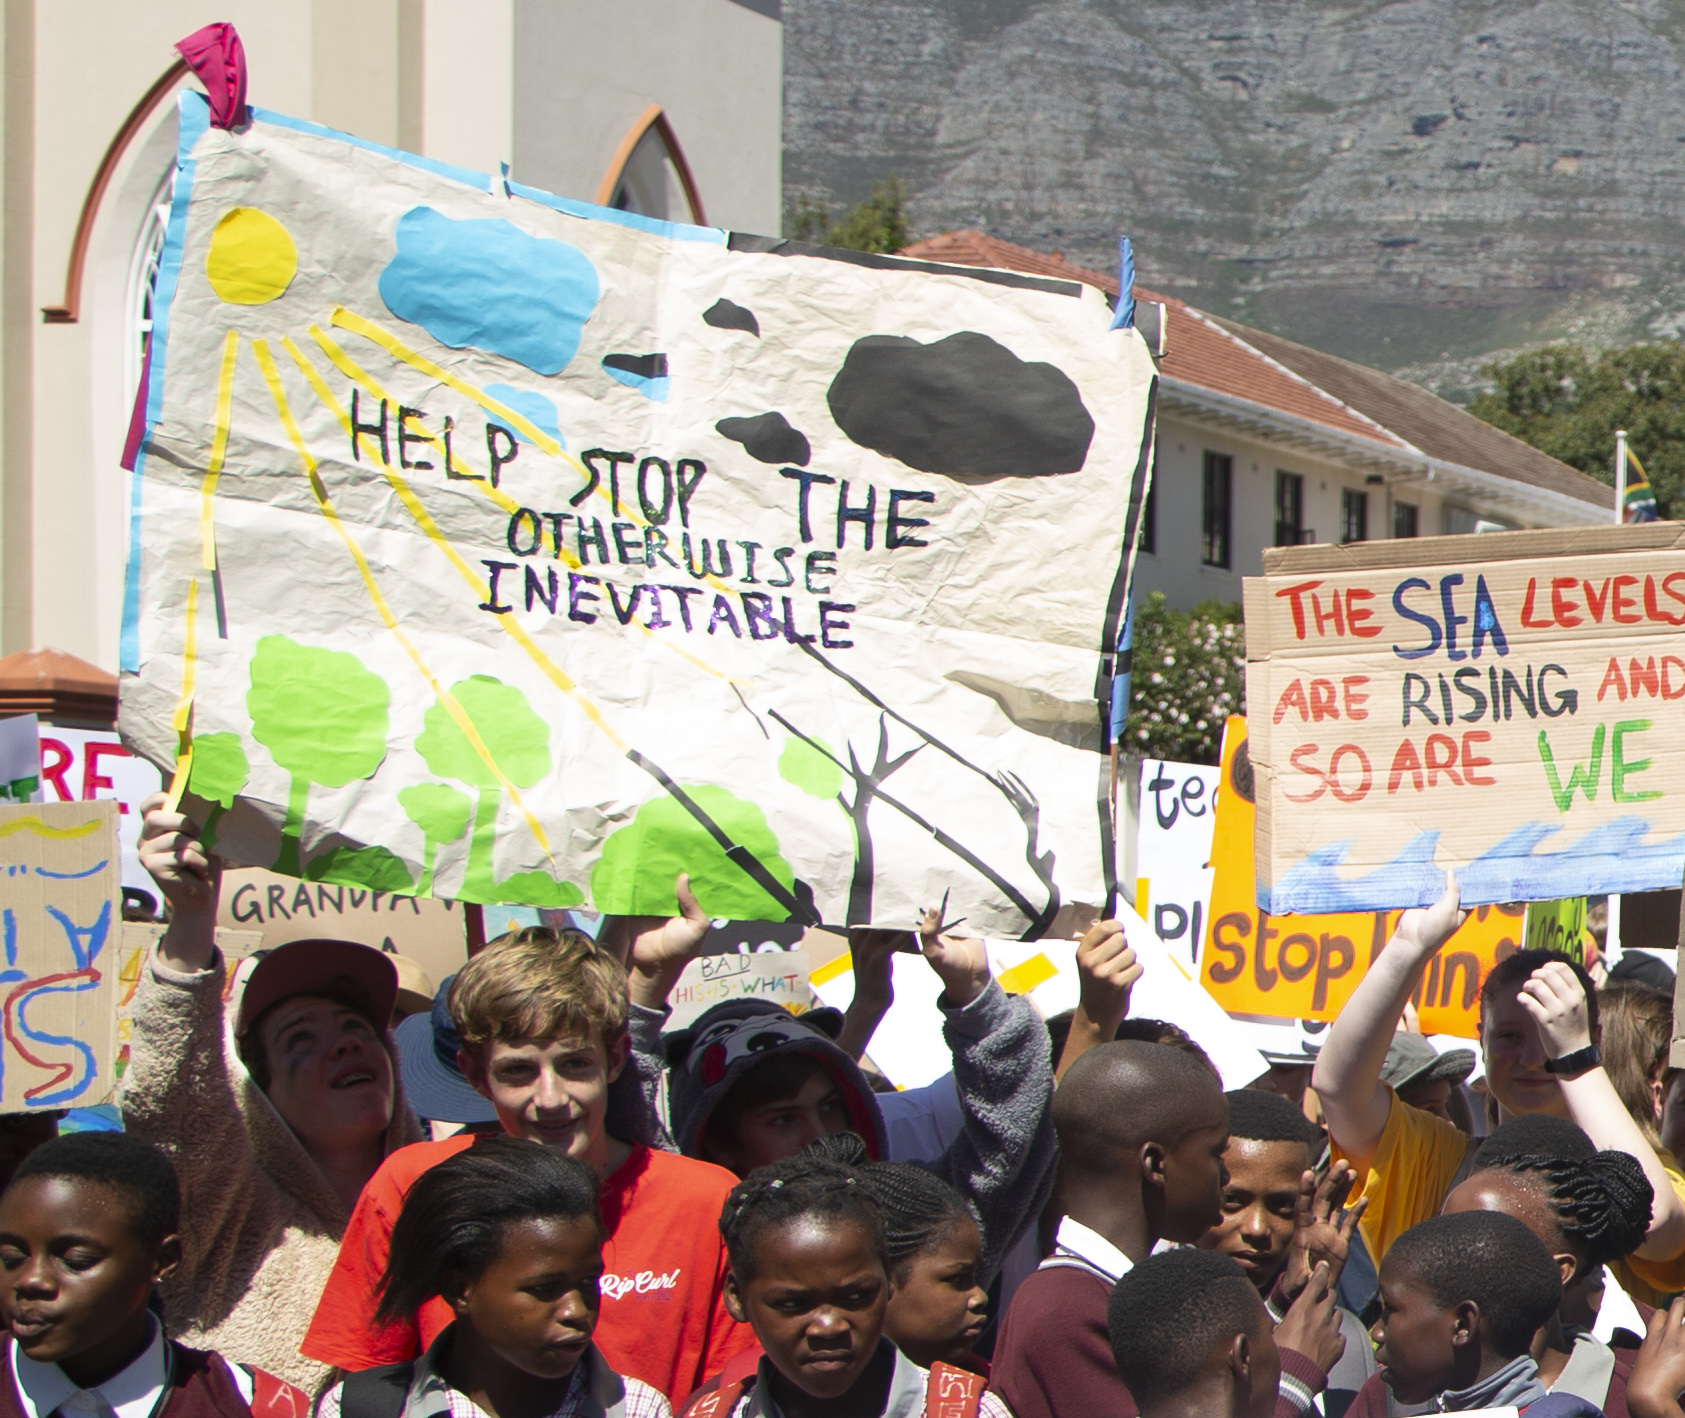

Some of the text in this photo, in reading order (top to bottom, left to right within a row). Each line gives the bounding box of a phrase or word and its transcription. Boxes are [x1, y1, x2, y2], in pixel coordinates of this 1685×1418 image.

[351, 388, 935, 551] HELP STOP THE
[506, 506, 837, 596] OTHERWISE
[478, 559, 857, 650] INEVITABLE
[1275, 580, 1386, 641] THE
[1391, 572, 1509, 661] SEA
[1273, 675, 1371, 726] ARE
[1402, 663, 1578, 727] RISING
[1282, 718, 1664, 814] SO ARE WE
[701, 953, 752, 978] BAD
[599, 1268, 681, 1301] Rip Curl
